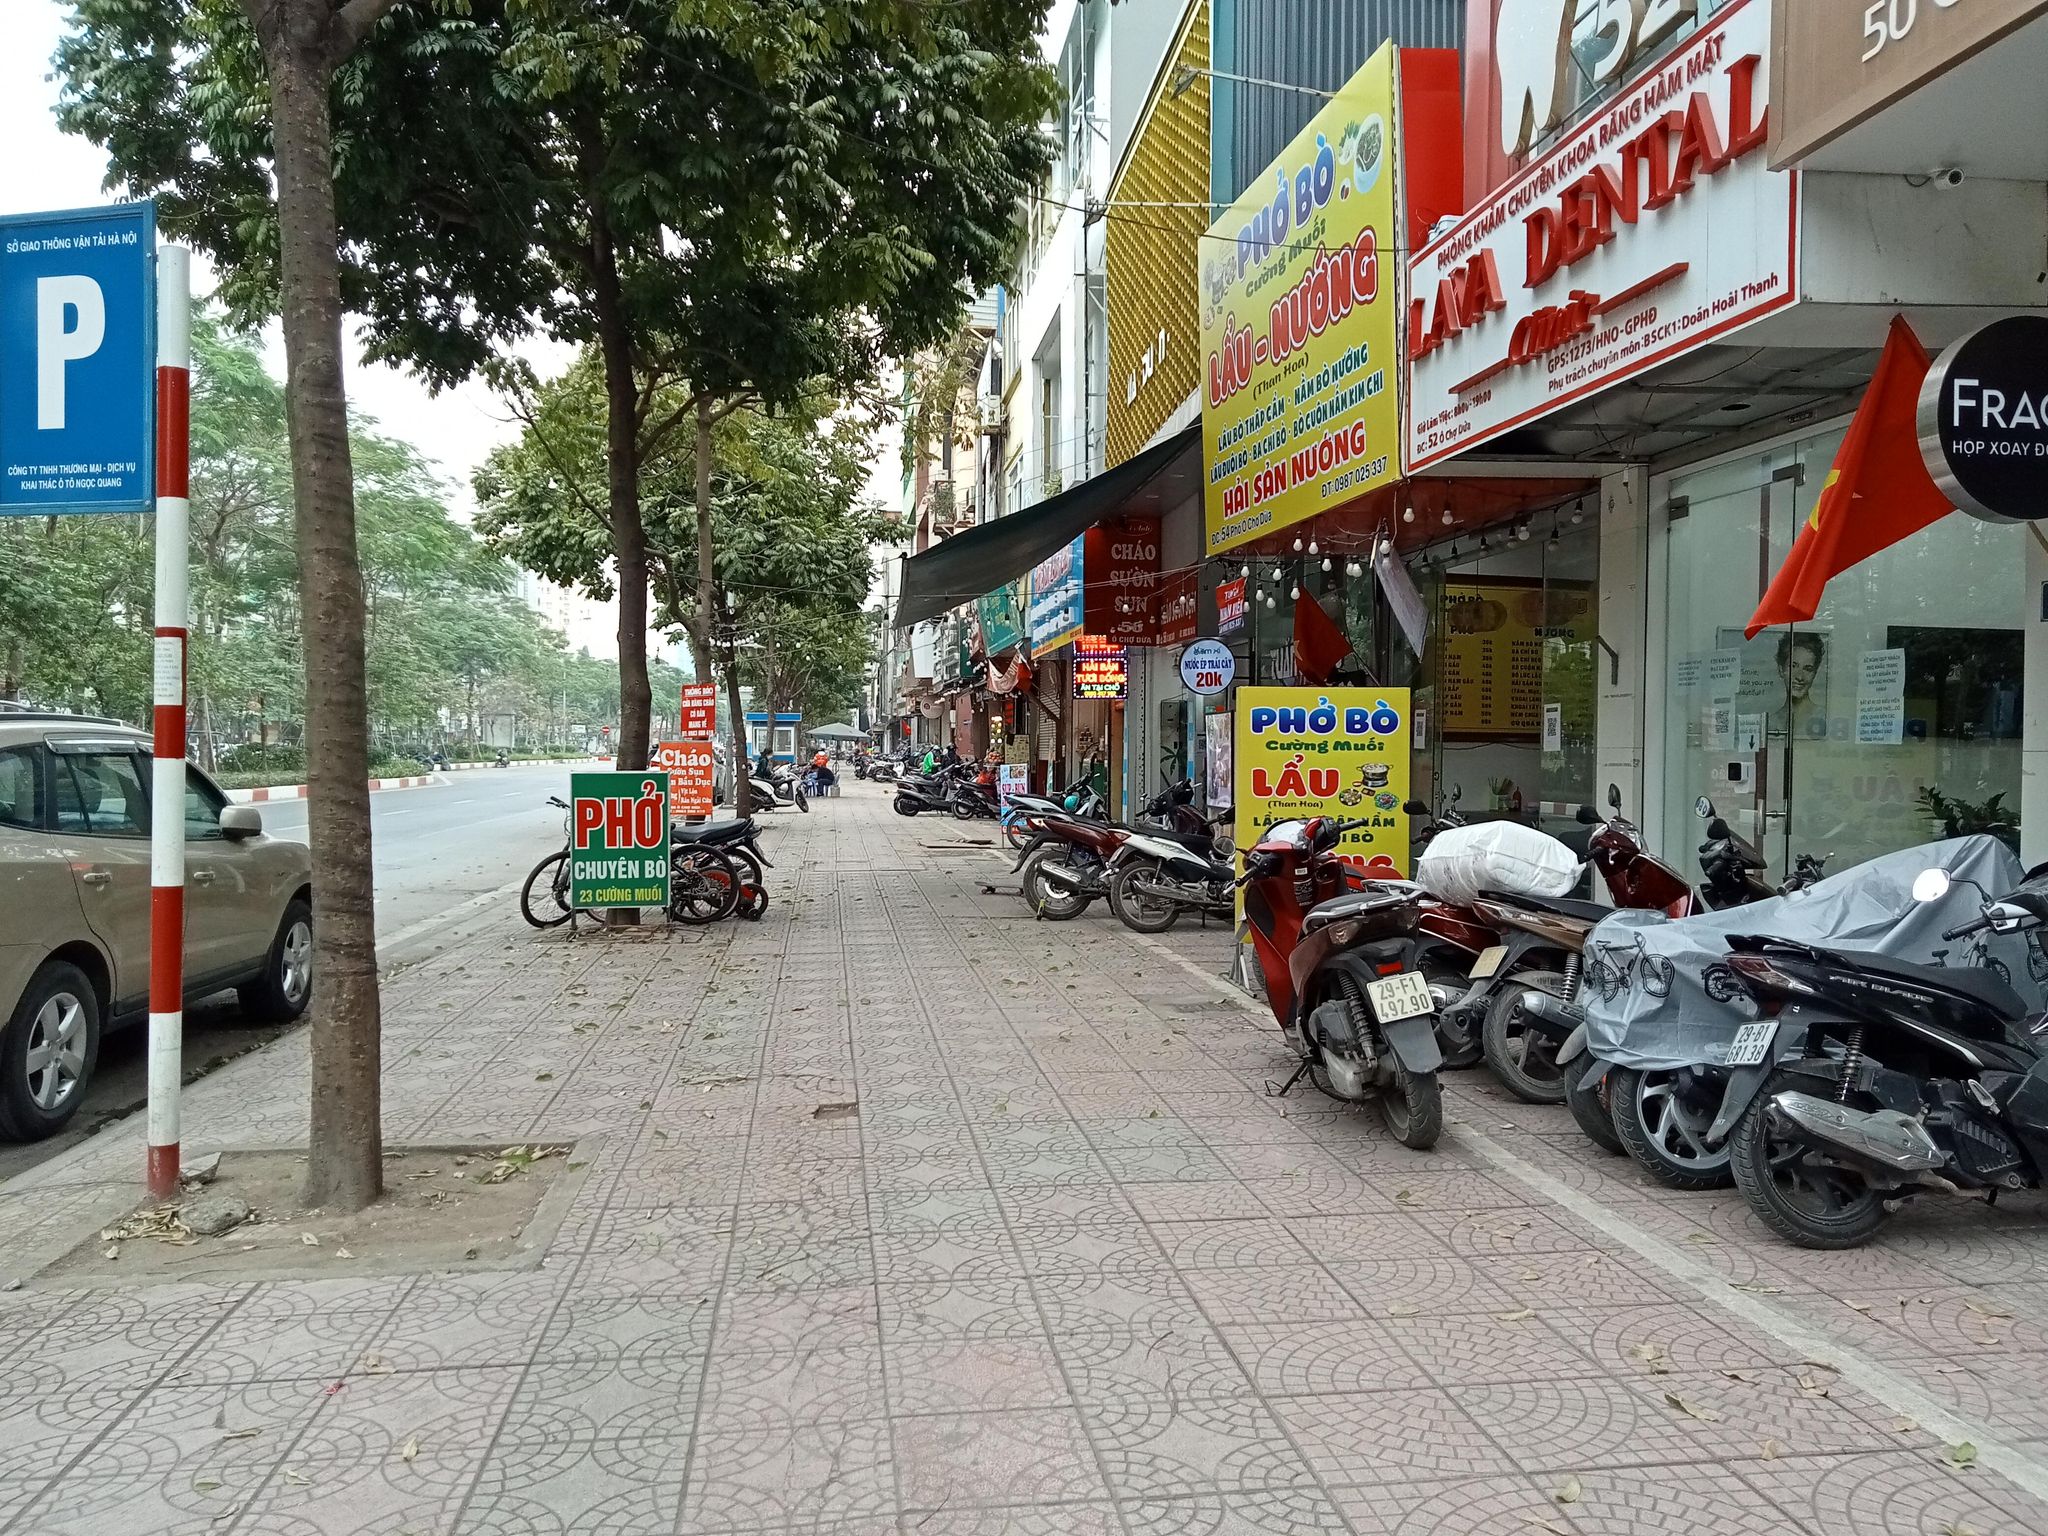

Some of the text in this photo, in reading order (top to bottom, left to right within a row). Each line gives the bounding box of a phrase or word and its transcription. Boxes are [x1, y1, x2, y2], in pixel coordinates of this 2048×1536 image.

[1437, 229, 1473, 270] PHÒNG
[1557, 133, 1598, 180] KHOA
[1599, 98, 1642, 148] RĂNG
[1644, 71, 1684, 114] HÀM
[1686, 31, 1727, 86] MẶT
[1237, 131, 1336, 281] PHỞ BÒ
[1408, 53, 1769, 362] LAVA DENTAL
[7, 230, 137, 253] SỞ GIAO THÔNG VẬN TẢI HÀ NỘI
[1245, 253, 1287, 299] Cường
[1208, 310, 1254, 410] LẨU
[1269, 225, 1379, 368] NƯỚNG
[1548, 375, 1564, 393] Phụ
[1741, 272, 1778, 299] Thanh
[37, 275, 106, 430] P
[1252, 352, 1310, 401] (Than Hoa)
[1232, 416, 1244, 444] BÒ
[1315, 362, 1330, 393] BÒ
[1330, 341, 1369, 384] NƯỚNG
[1238, 444, 1248, 470] BÒ
[1251, 440, 1263, 463] BA
[1275, 420, 1287, 449] BÒ
[1293, 409, 1305, 440] BÒ
[1348, 379, 1366, 408] KIM
[1366, 368, 1385, 398] CHI
[1428, 432, 1438, 450] 52
[1990, 441, 2030, 456] XOAY
[8, 464, 27, 475] CÔNG
[29, 466, 37, 475] TY
[40, 465, 58, 474] TNHH
[60, 463, 88, 474] THƯƠNG
[107, 462, 124, 474] DỊCH
[126, 462, 136, 474] VỤ
[1223, 417, 1367, 520] HẢI SẢN NƯỚNG
[1354, 455, 1388, 484] 025 337
[21, 476, 122, 490] KHAI THÁC Ô TÔ NGỌC QUANG
[1111, 539, 1156, 560] CHÁO
[1195, 671, 1223, 688] 20k
[1250, 696, 1400, 736] PHỞ BÒ
[660, 748, 711, 767] Cháo
[1265, 736, 1385, 754] Cường Muối
[688, 767, 704, 777] Sụn
[695, 777, 711, 788] Dục
[1251, 753, 1341, 799] LẨU
[574, 780, 665, 850] PHỞ
[1267, 800, 1324, 810] (Than Hoa)
[1350, 829, 1375, 843] BÒ
[575, 854, 667, 880] CHUYÊN BÒ
[579, 883, 662, 903] 23 CƯỜNG MUỐI
[1377, 975, 1418, 1001] 29-F1
[1380, 993, 1430, 1019] 492.90
[1726, 1044, 1764, 1062] 681.38
